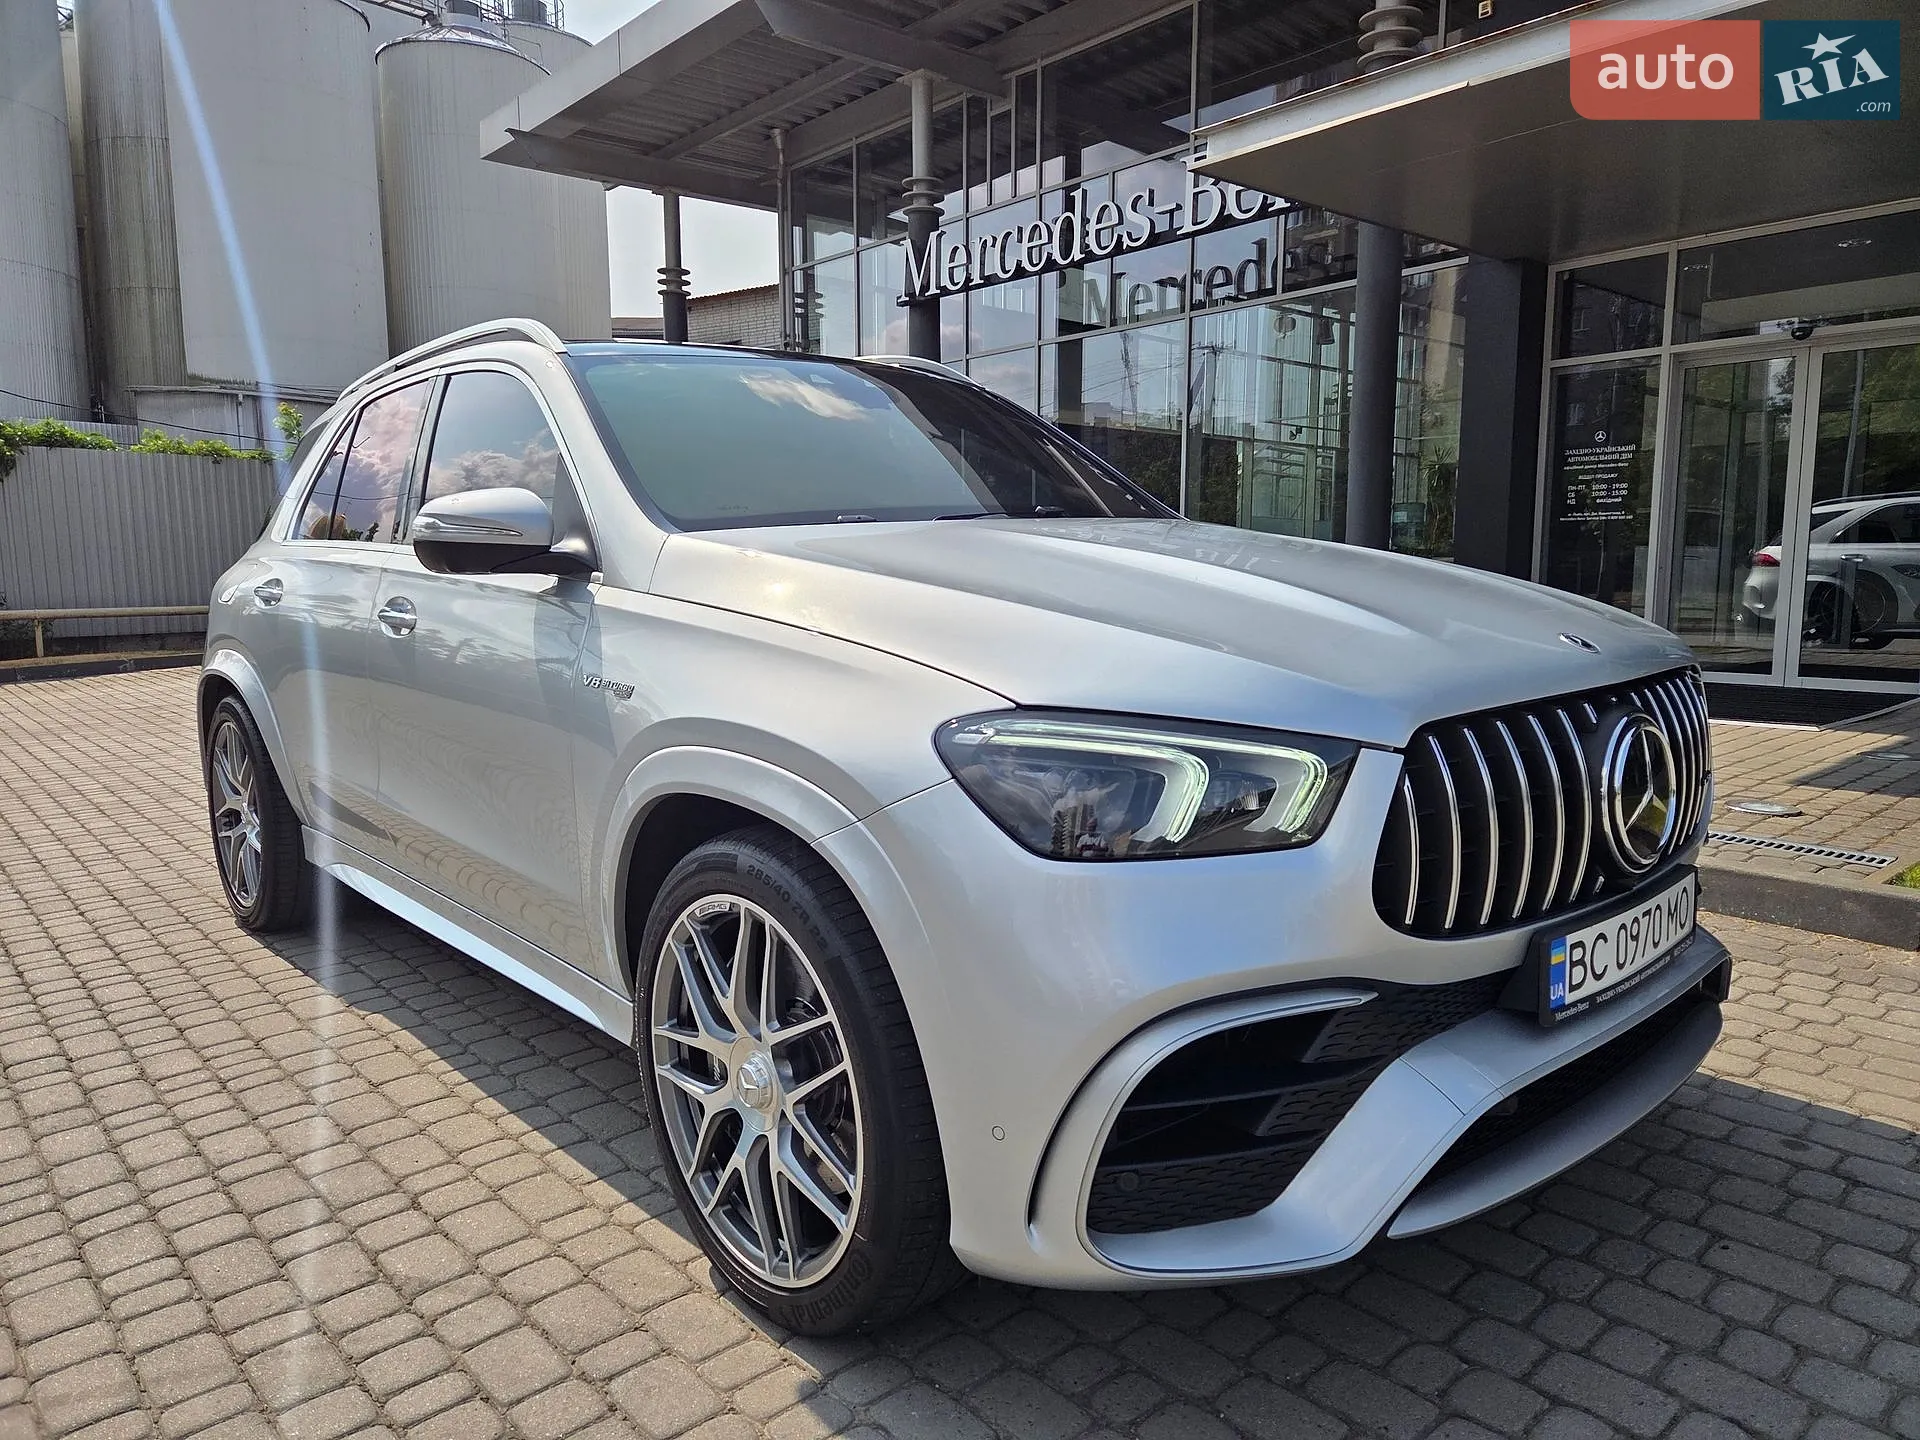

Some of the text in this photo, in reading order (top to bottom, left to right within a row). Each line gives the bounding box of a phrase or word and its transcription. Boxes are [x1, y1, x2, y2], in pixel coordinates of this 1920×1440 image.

[897, 153, 1291, 304] Mercedes-Be
[1591, 483, 1608, 491] 10:00
[1612, 482, 1629, 490] 19:00
[1591, 490, 1608, 498] 10:00
[583, 674, 635, 692] V8 BITURBO
[1568, 932, 1609, 994] BC
[1616, 903, 1663, 971] 0970
[1666, 886, 1689, 943] MO
[1550, 982, 1564, 1001] UA
